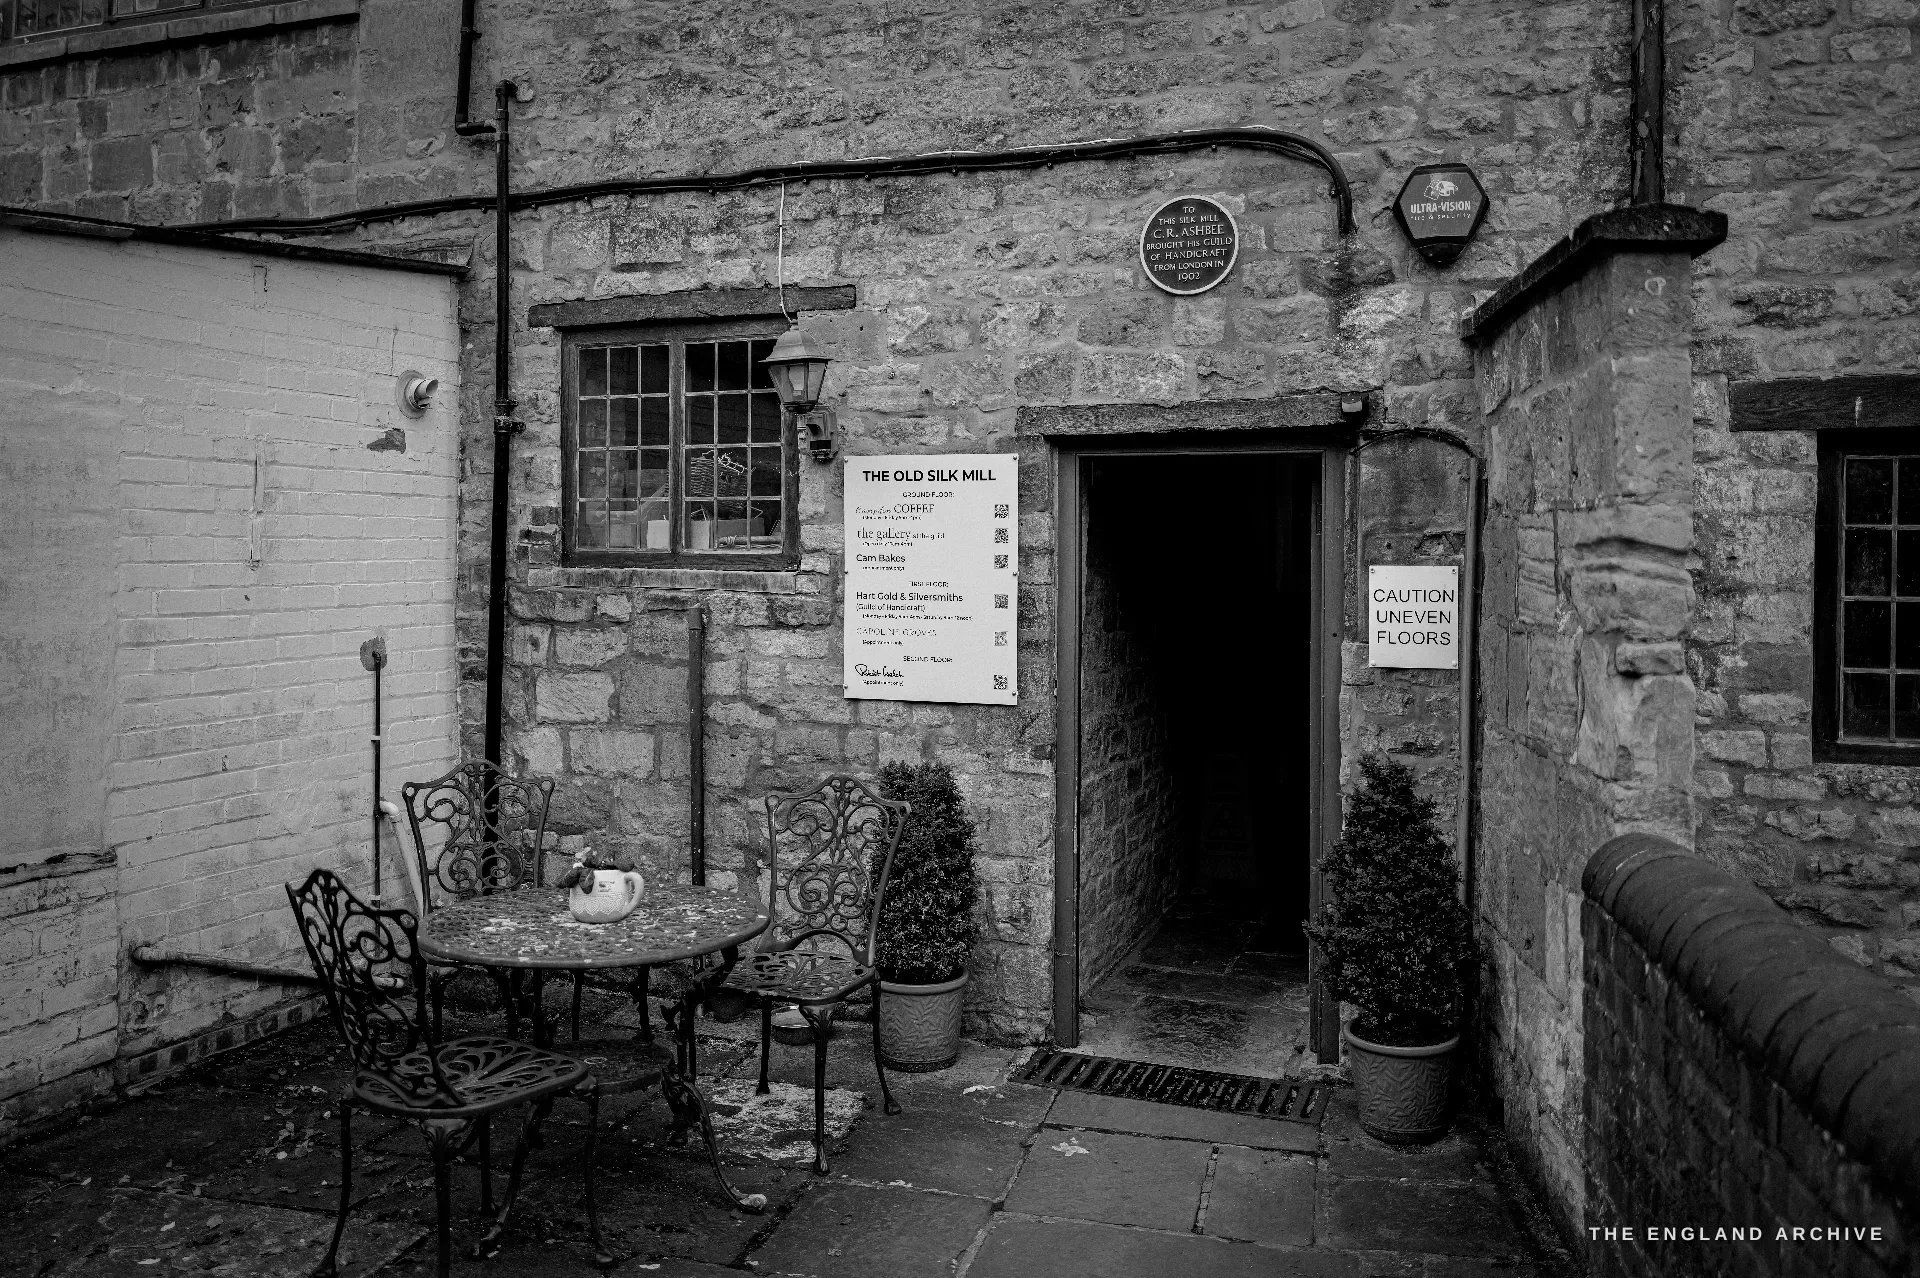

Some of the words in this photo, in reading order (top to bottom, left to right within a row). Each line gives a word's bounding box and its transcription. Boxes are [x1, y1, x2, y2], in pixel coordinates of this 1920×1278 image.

[1183, 206, 1195, 214] TO
[1410, 201, 1471, 213] ULTRA-VISION
[1158, 217, 1176, 226] THIS
[1179, 216, 1196, 224] SILK
[1200, 214, 1219, 222] MILL
[1181, 224, 1224, 237] ASHBEE
[1146, 240, 1185, 250] BROUGHT
[1187, 240, 1200, 248] HIS
[1203, 237, 1233, 246] GUILD
[1150, 253, 1161, 261] OF
[1165, 248, 1228, 260] HANDICRAFT
[1154, 263, 1176, 272] FROM
[1178, 261, 1213, 270] LONDON
[1214, 260, 1224, 268] IN
[1178, 272, 1201, 282] 1902
[862, 470, 890, 482] THE
[893, 470, 924, 482] OLD
[927, 469, 959, 482] SILK
[962, 469, 997, 481] MILL
[893, 503, 935, 513] COFFEE
[857, 527, 874, 539] the
[876, 527, 911, 541] gallery
[856, 553, 877, 562] Cam
[878, 553, 906, 563] Bakes
[856, 591, 876, 600] Hart
[877, 591, 898, 601] Gold
[900, 592, 907, 601] &
[908, 592, 964, 602] Silversmiths
[1373, 589, 1454, 603] CAUTION
[1376, 610, 1451, 624] UNEVEN
[1377, 630, 1451, 646] FLOORS
